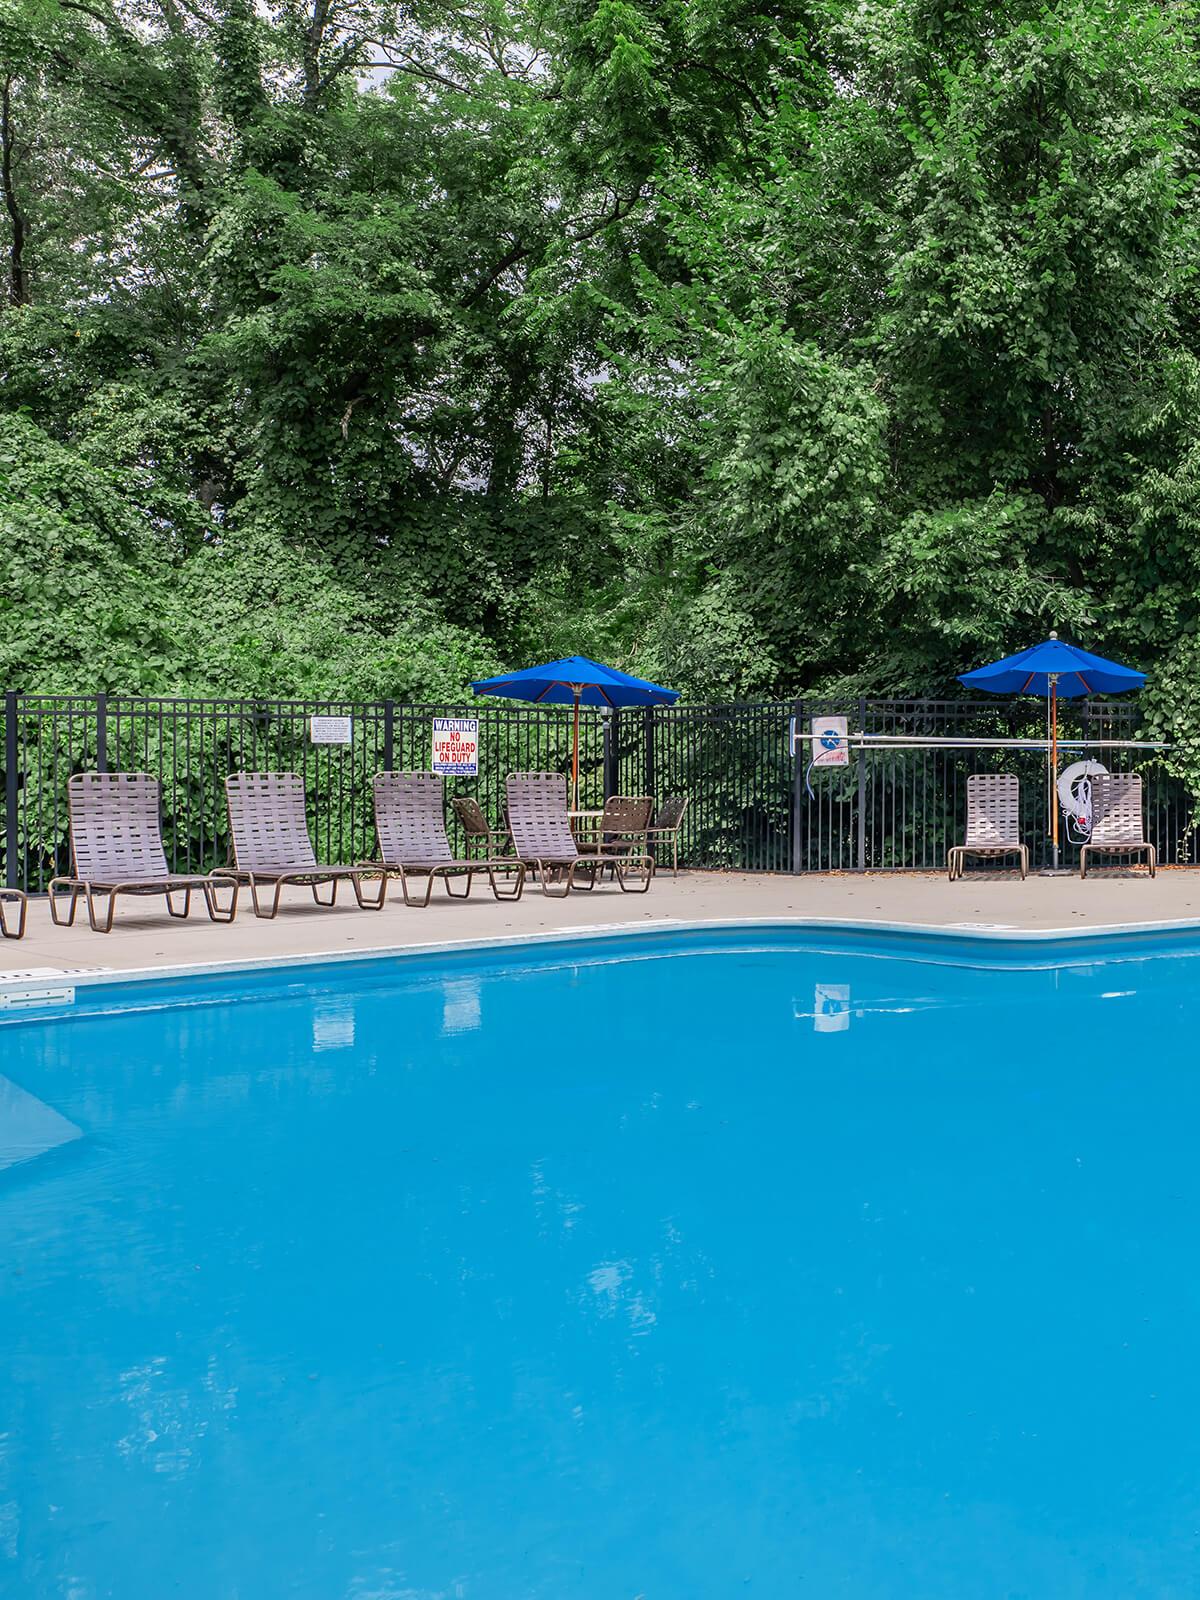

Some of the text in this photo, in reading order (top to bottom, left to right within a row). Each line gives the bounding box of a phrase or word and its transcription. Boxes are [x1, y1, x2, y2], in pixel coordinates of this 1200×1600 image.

[435, 720, 476, 732] WARNING
[450, 732, 461, 742] NO
[435, 742, 476, 752] LIFEGUARD
[439, 752, 471, 762] ON DUTY
